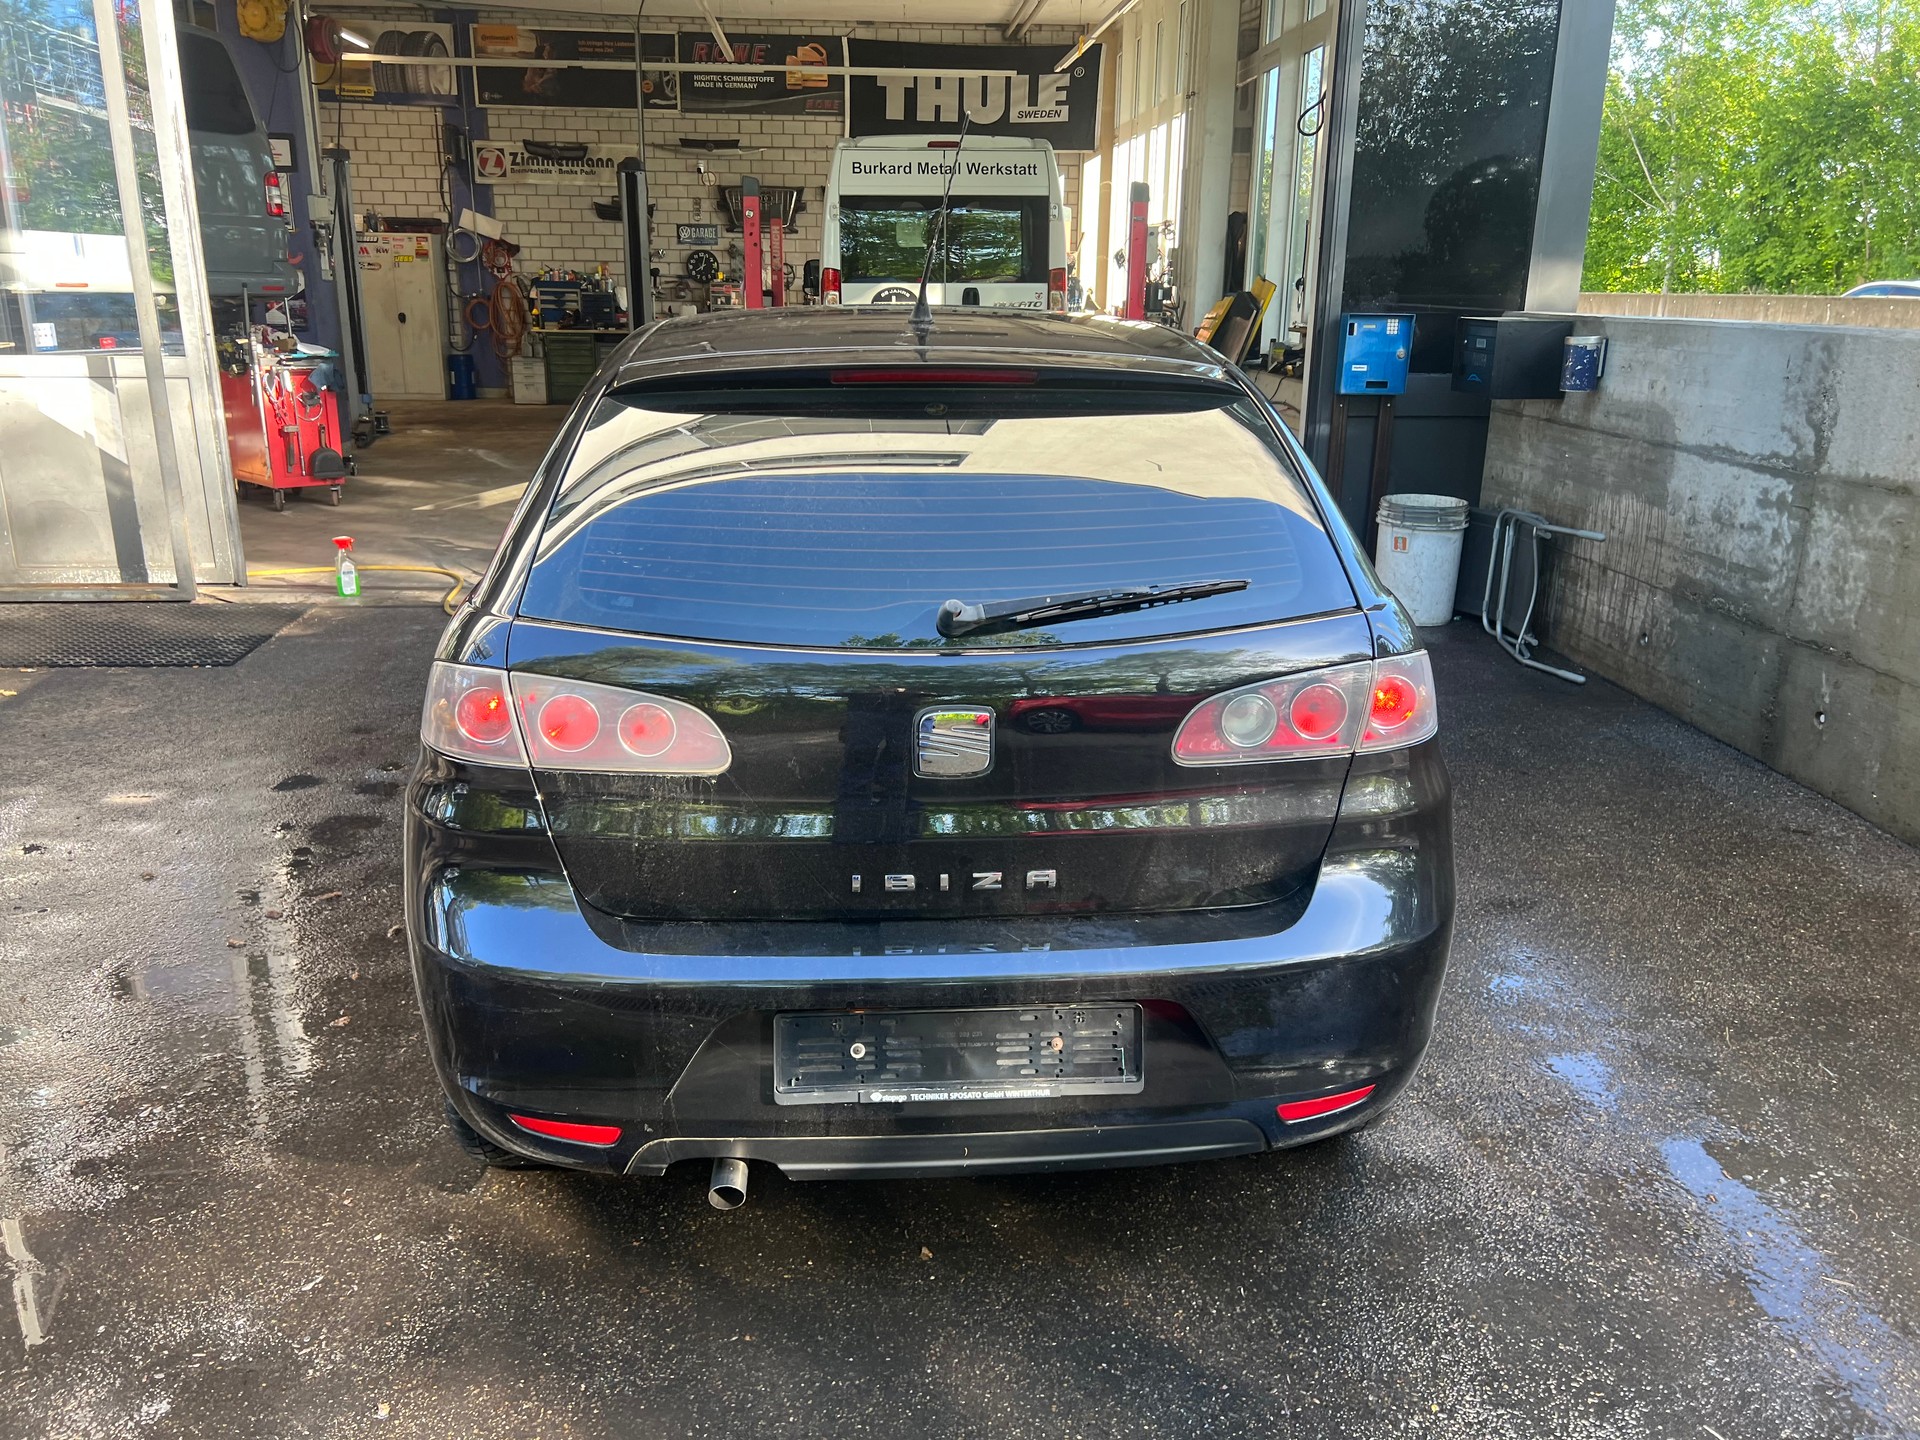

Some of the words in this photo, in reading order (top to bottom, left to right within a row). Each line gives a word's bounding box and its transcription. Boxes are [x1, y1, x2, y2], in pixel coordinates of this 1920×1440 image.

[1017, 109, 1062, 119] SWEDEN
[509, 152, 615, 168] Zimmermann
[852, 161, 912, 175] Burkard
[966, 162, 1038, 175] Werkstatt
[691, 228, 716, 238] GARAGE
[851, 869, 1057, 893] IBIZA
[910, 1093, 949, 1101] TECHNIKER
[949, 1091, 982, 1100] SPOSATO
[983, 1091, 1004, 1099] GmbH
[1005, 1089, 1051, 1098] WINTERTHUR
